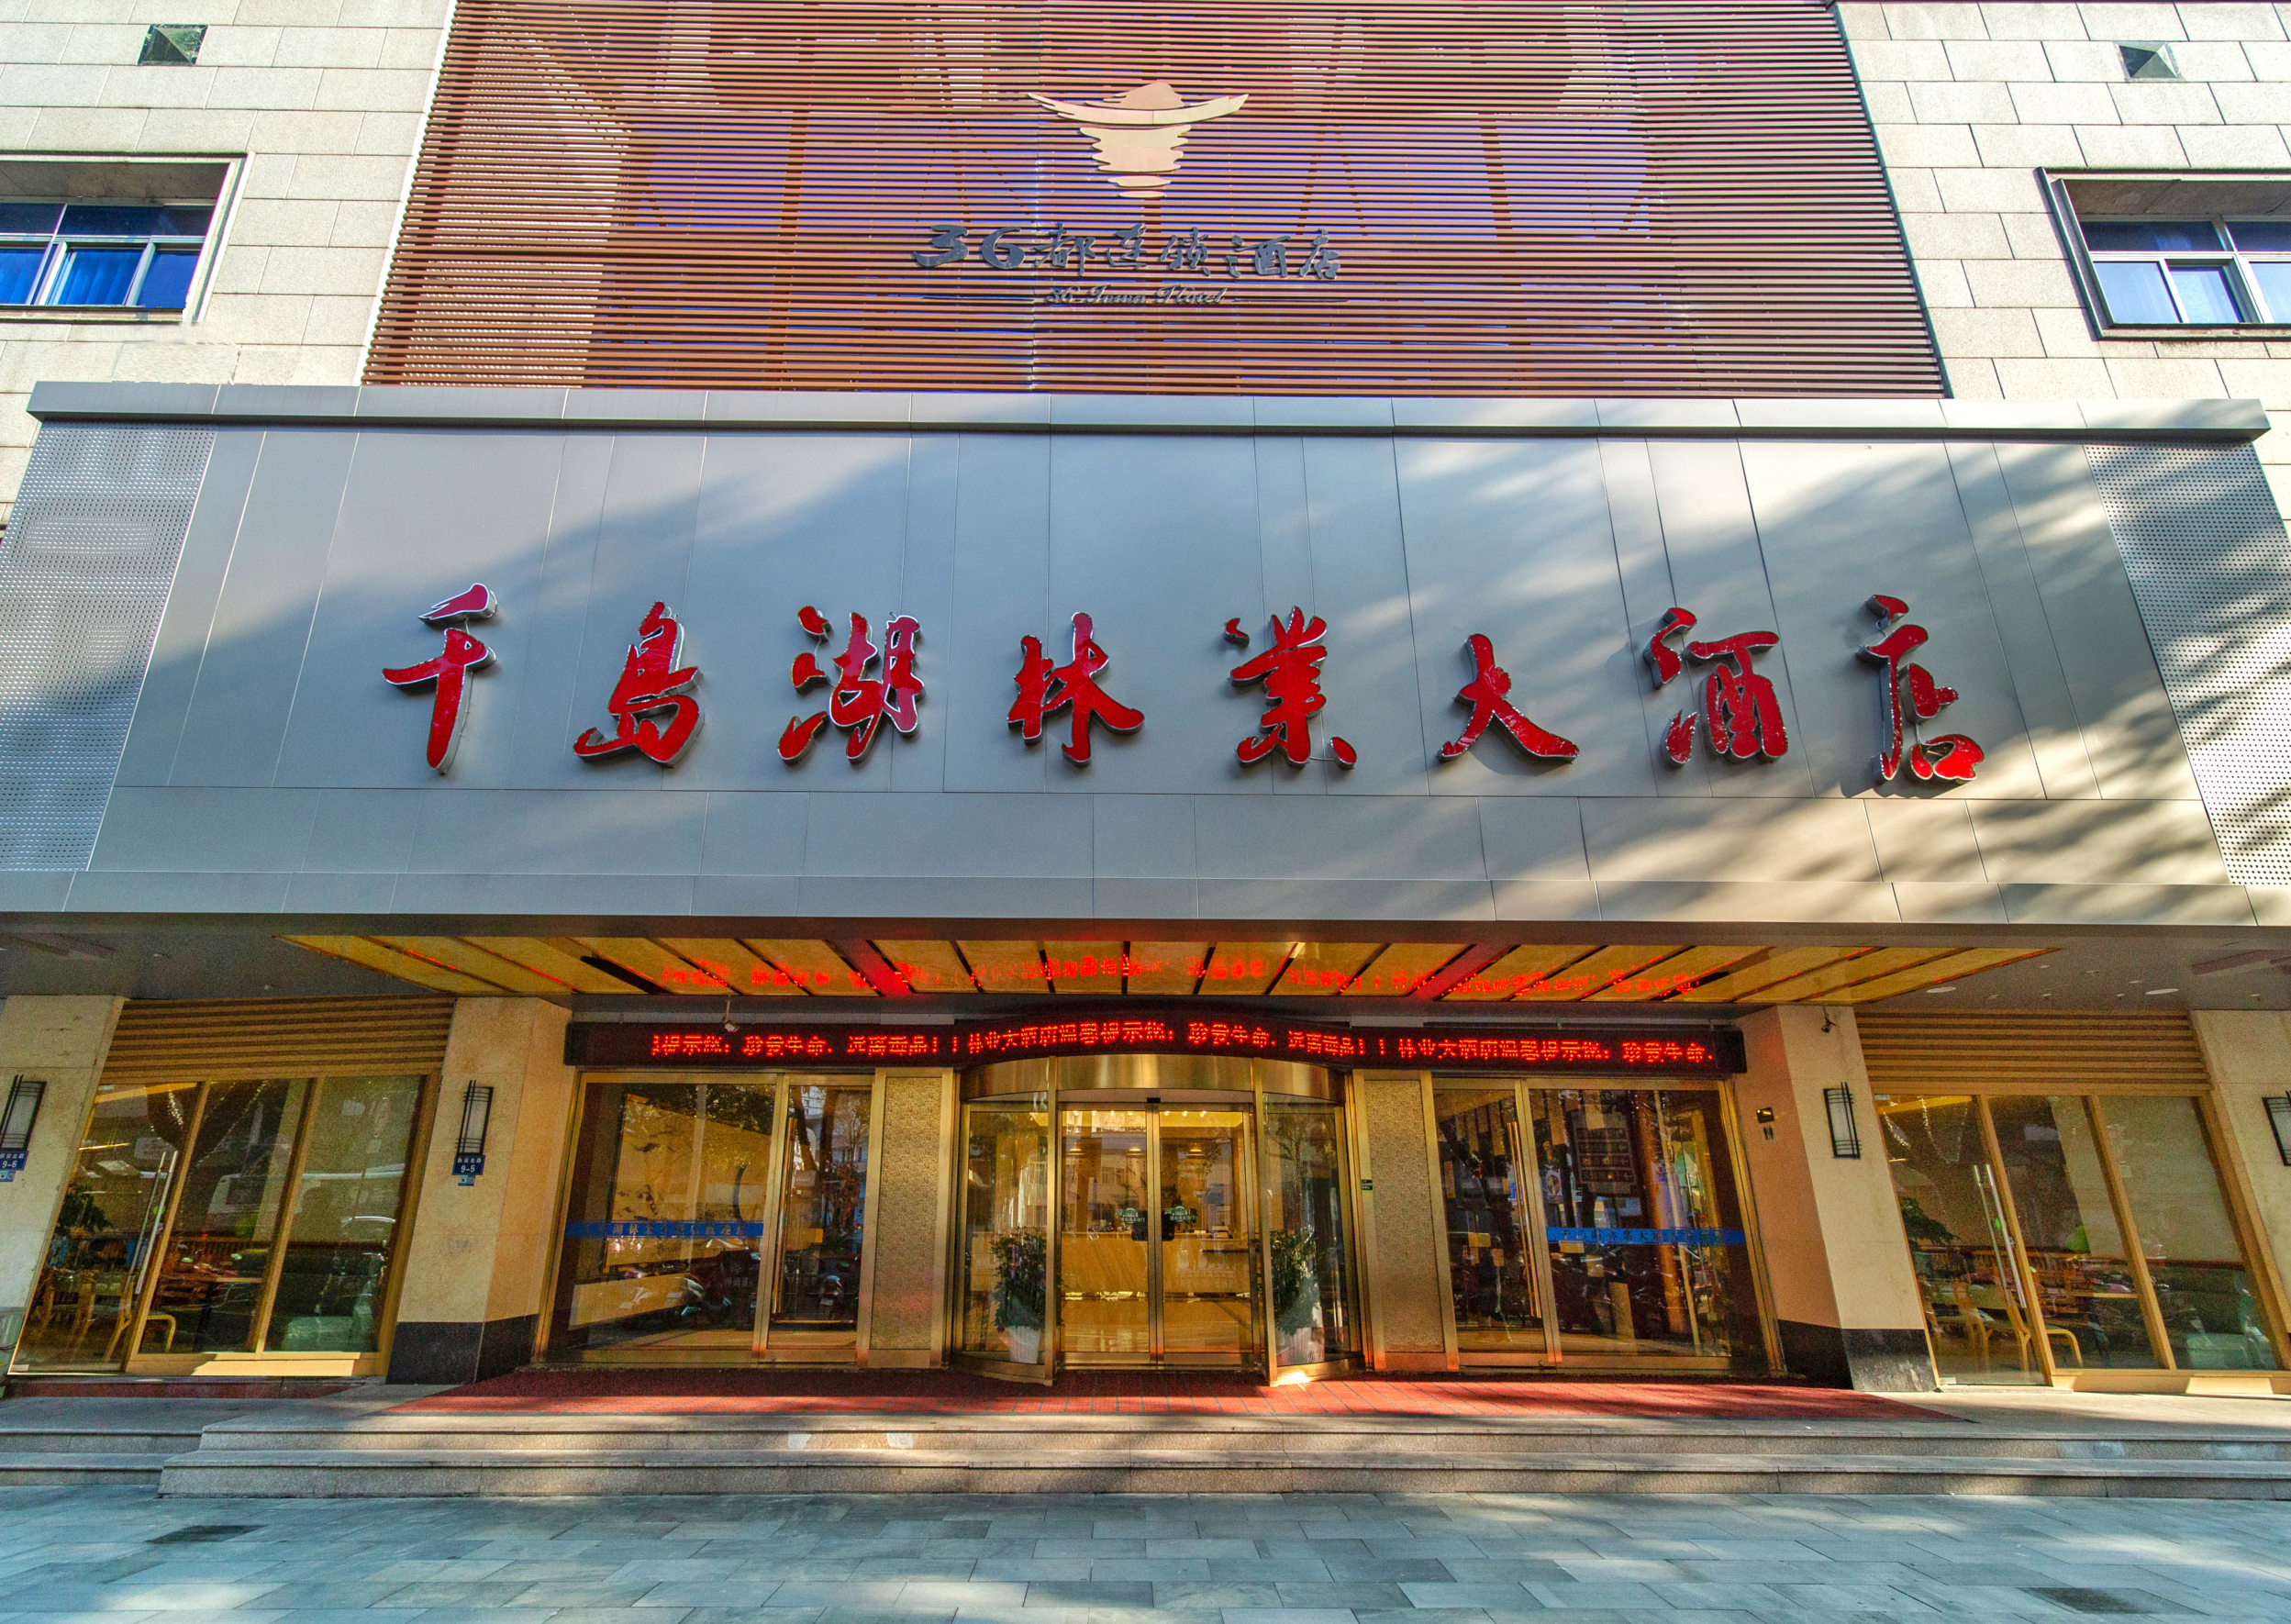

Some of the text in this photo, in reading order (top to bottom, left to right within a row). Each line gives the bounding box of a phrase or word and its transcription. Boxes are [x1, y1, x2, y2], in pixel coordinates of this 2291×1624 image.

[1151, 284, 1229, 304] Hotel
[2, 1160, 17, 1168] 9-6
[461, 1164, 475, 1173] 9-5
